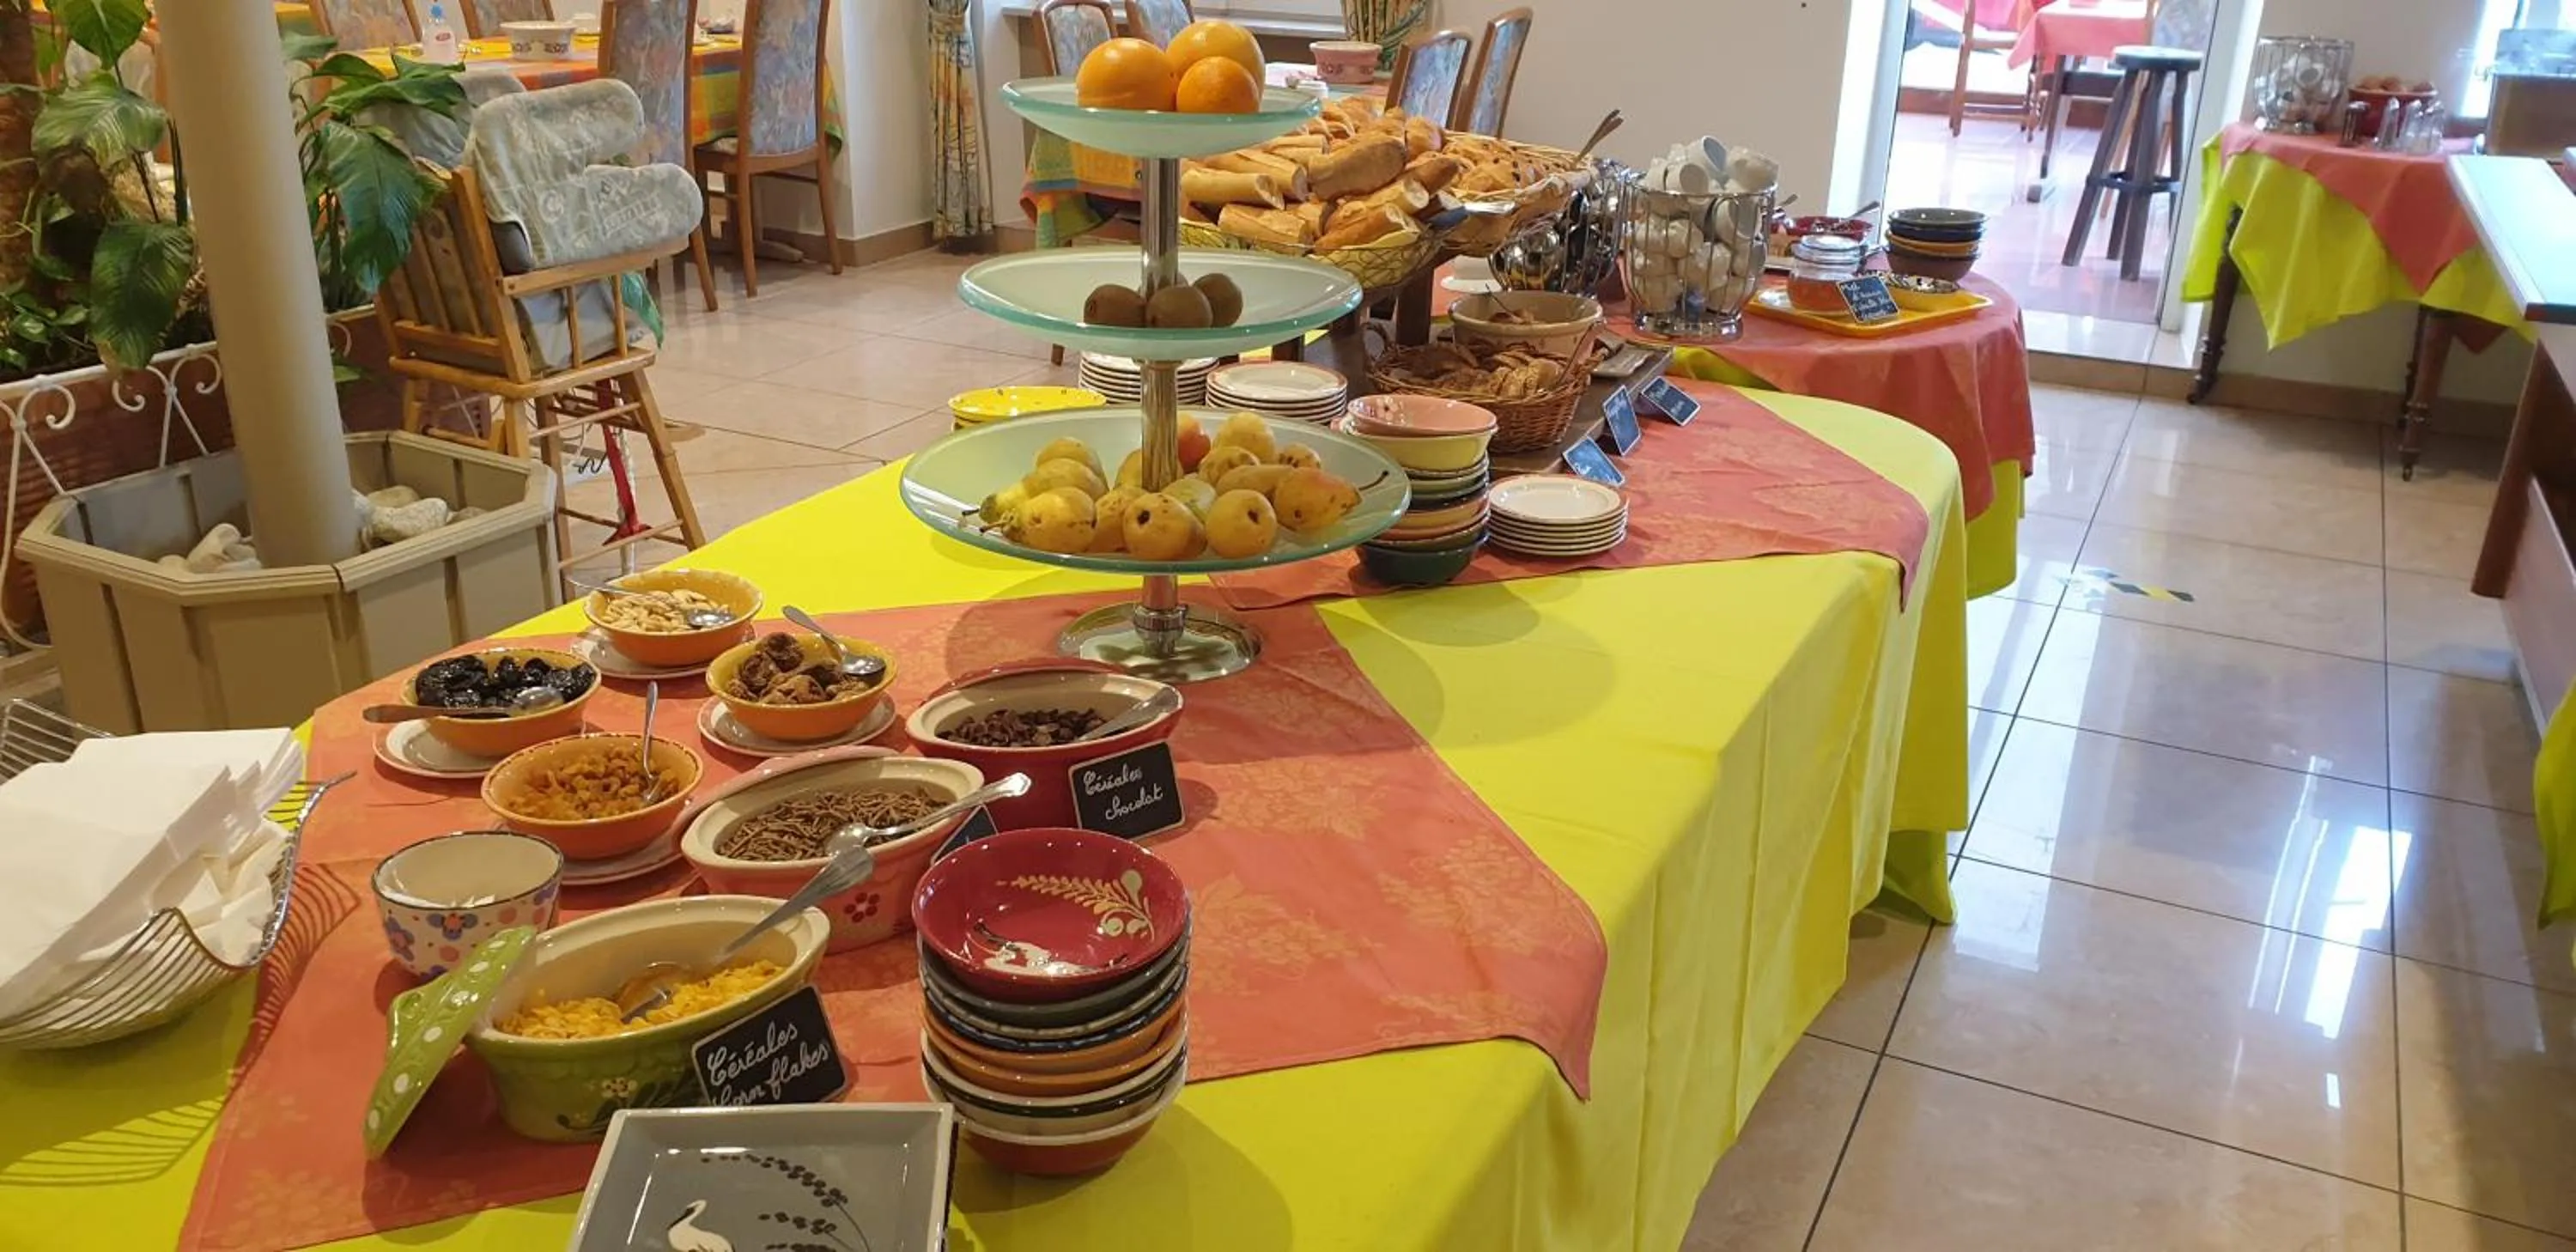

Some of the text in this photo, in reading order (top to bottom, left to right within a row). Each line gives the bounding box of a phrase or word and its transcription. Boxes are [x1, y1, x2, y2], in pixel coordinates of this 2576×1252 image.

[1083, 763, 1143, 796] Céréales
[1105, 782, 1163, 820] chocolat
[707, 1020, 799, 1086] Céréales
[763, 1041, 829, 1100] flakes
